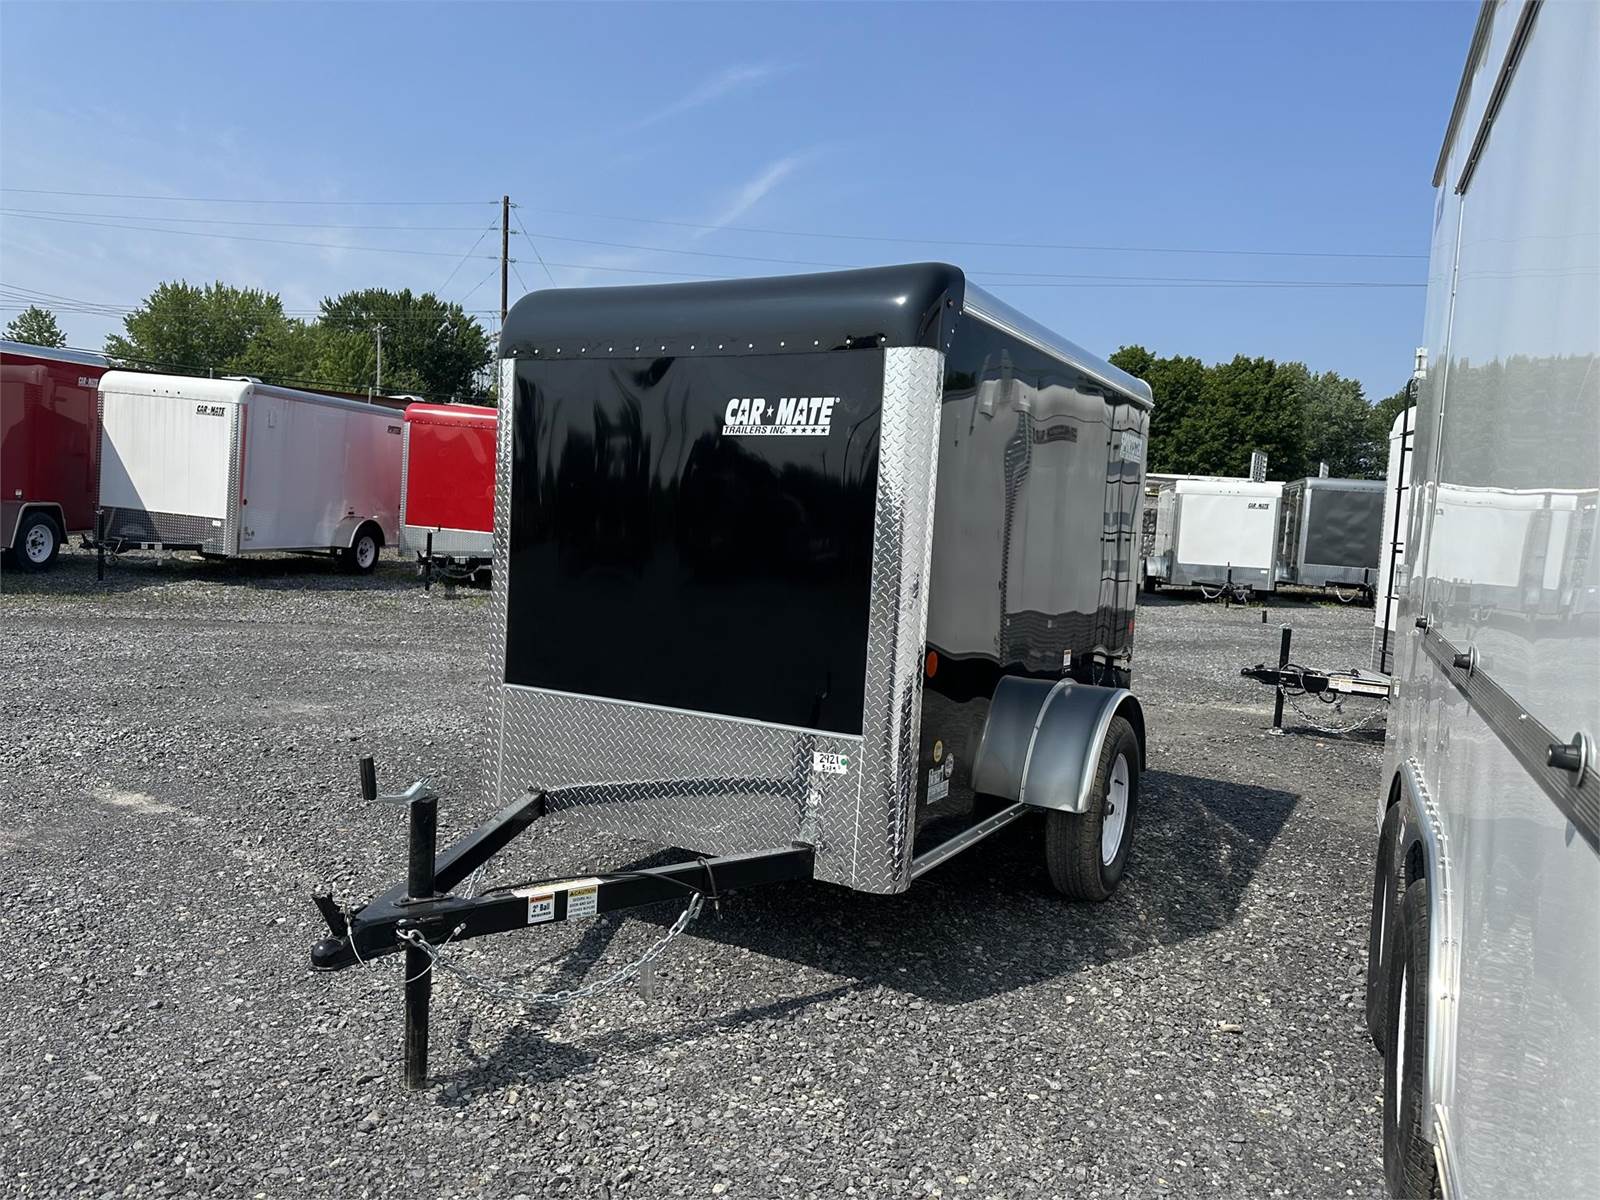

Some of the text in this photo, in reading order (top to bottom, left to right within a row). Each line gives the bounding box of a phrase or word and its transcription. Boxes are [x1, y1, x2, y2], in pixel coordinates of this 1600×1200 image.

[725, 397, 835, 425] CAR MATE
[724, 426, 788, 435] TRAILERS INC.
